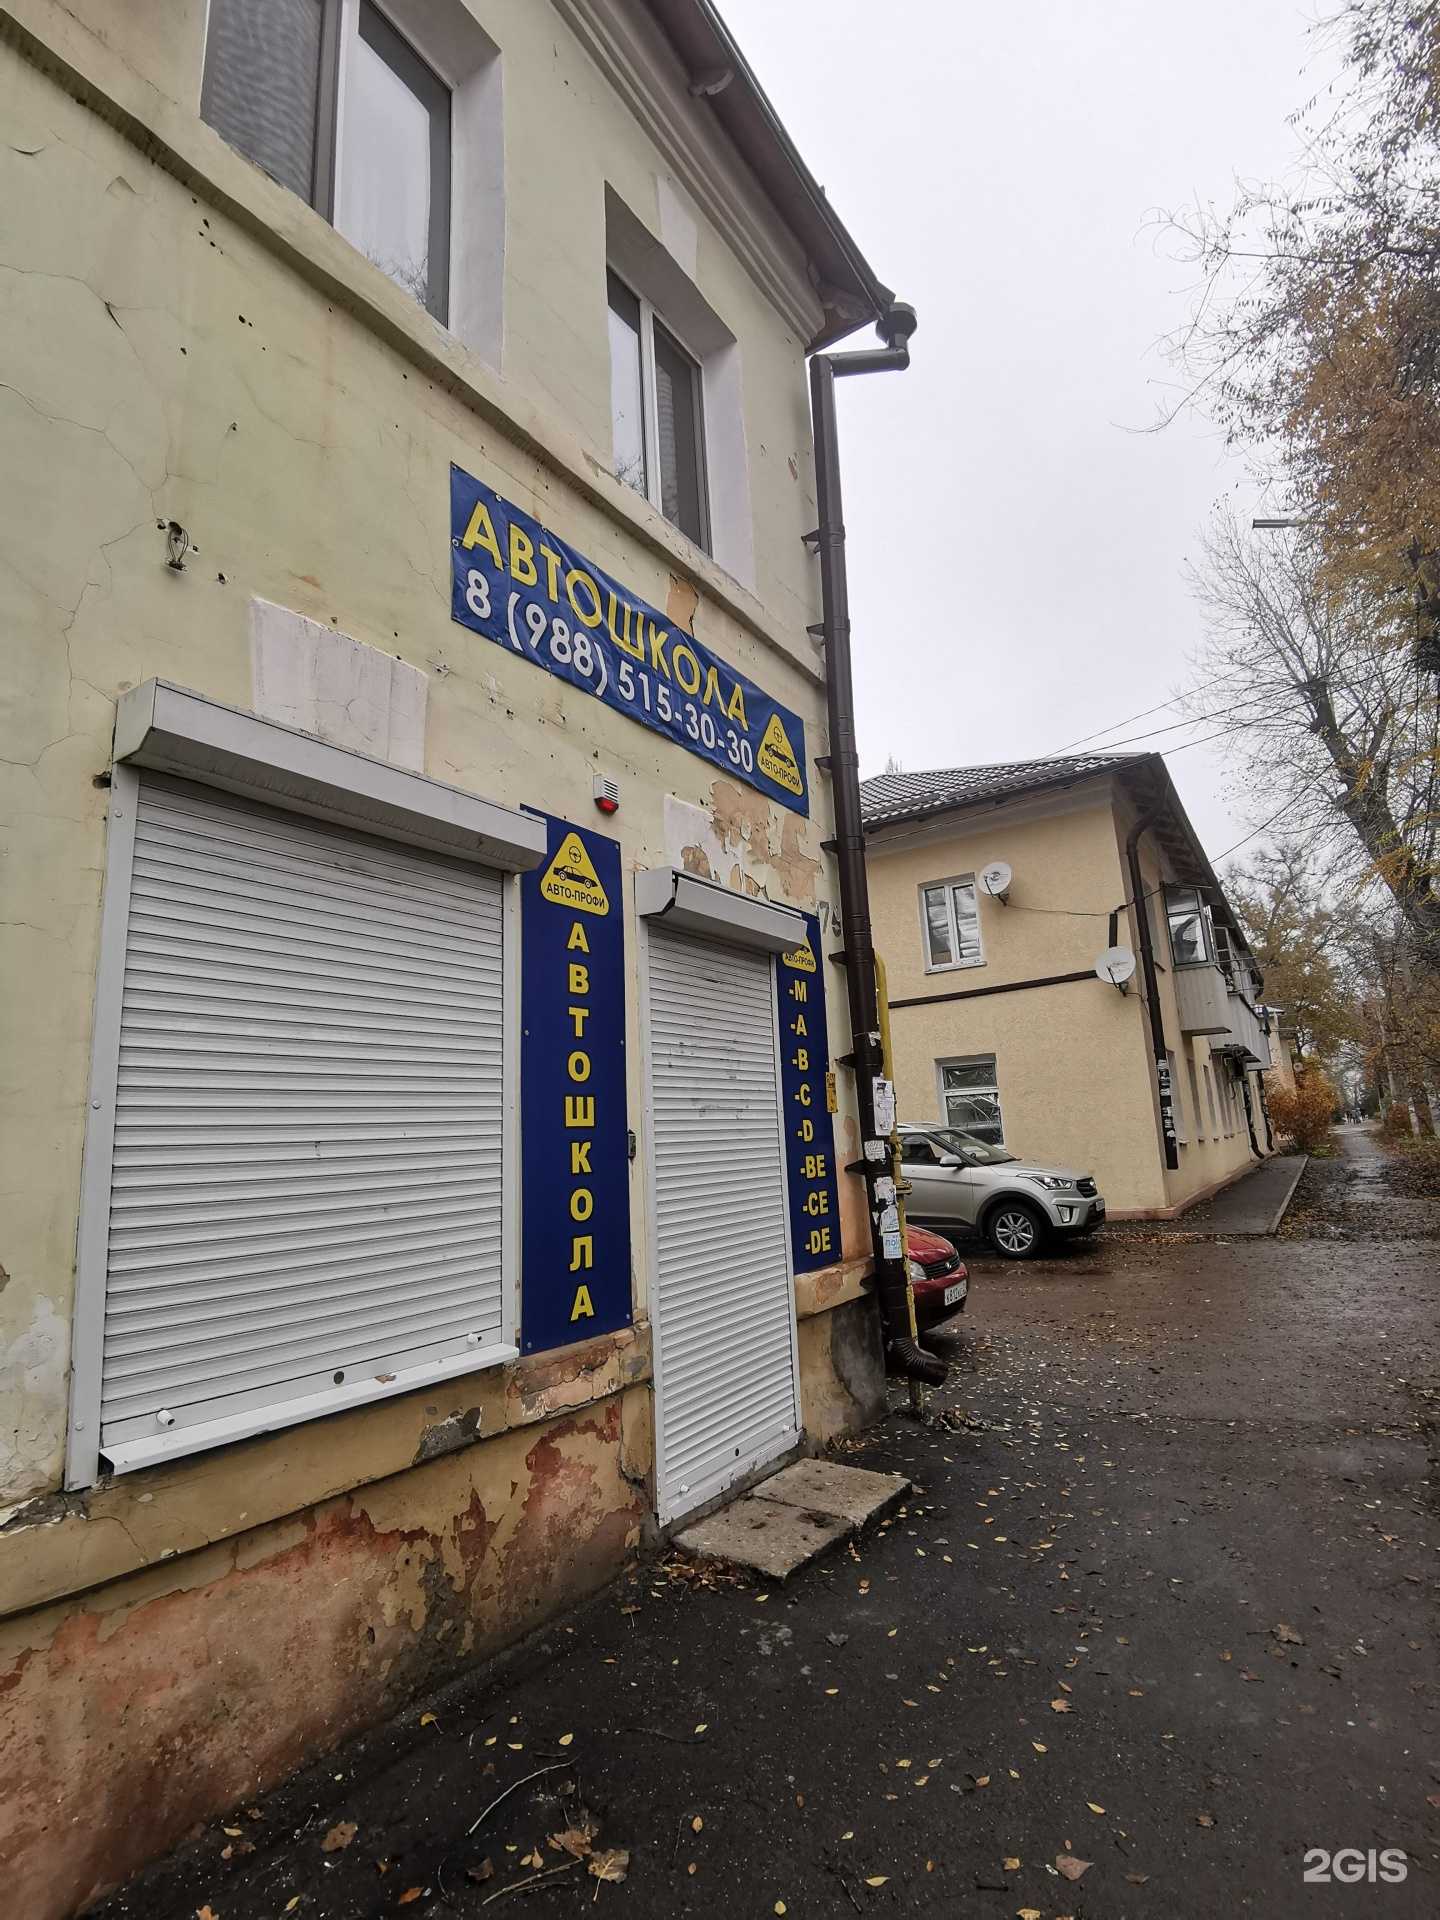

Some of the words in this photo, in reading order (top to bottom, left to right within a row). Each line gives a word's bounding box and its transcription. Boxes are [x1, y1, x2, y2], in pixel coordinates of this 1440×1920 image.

[462, 500, 749, 732] АВТОШКОЛА
[466, 568, 492, 619] 8
[507, 591, 608, 697] (988)
[618, 659, 753, 773] 515-30-30
[761, 756, 800, 787] АВТО-ПРОФИ
[546, 882, 605, 909] АВТО-ПРОФИ
[564, 922, 596, 1321] АВТОШКОЛА
